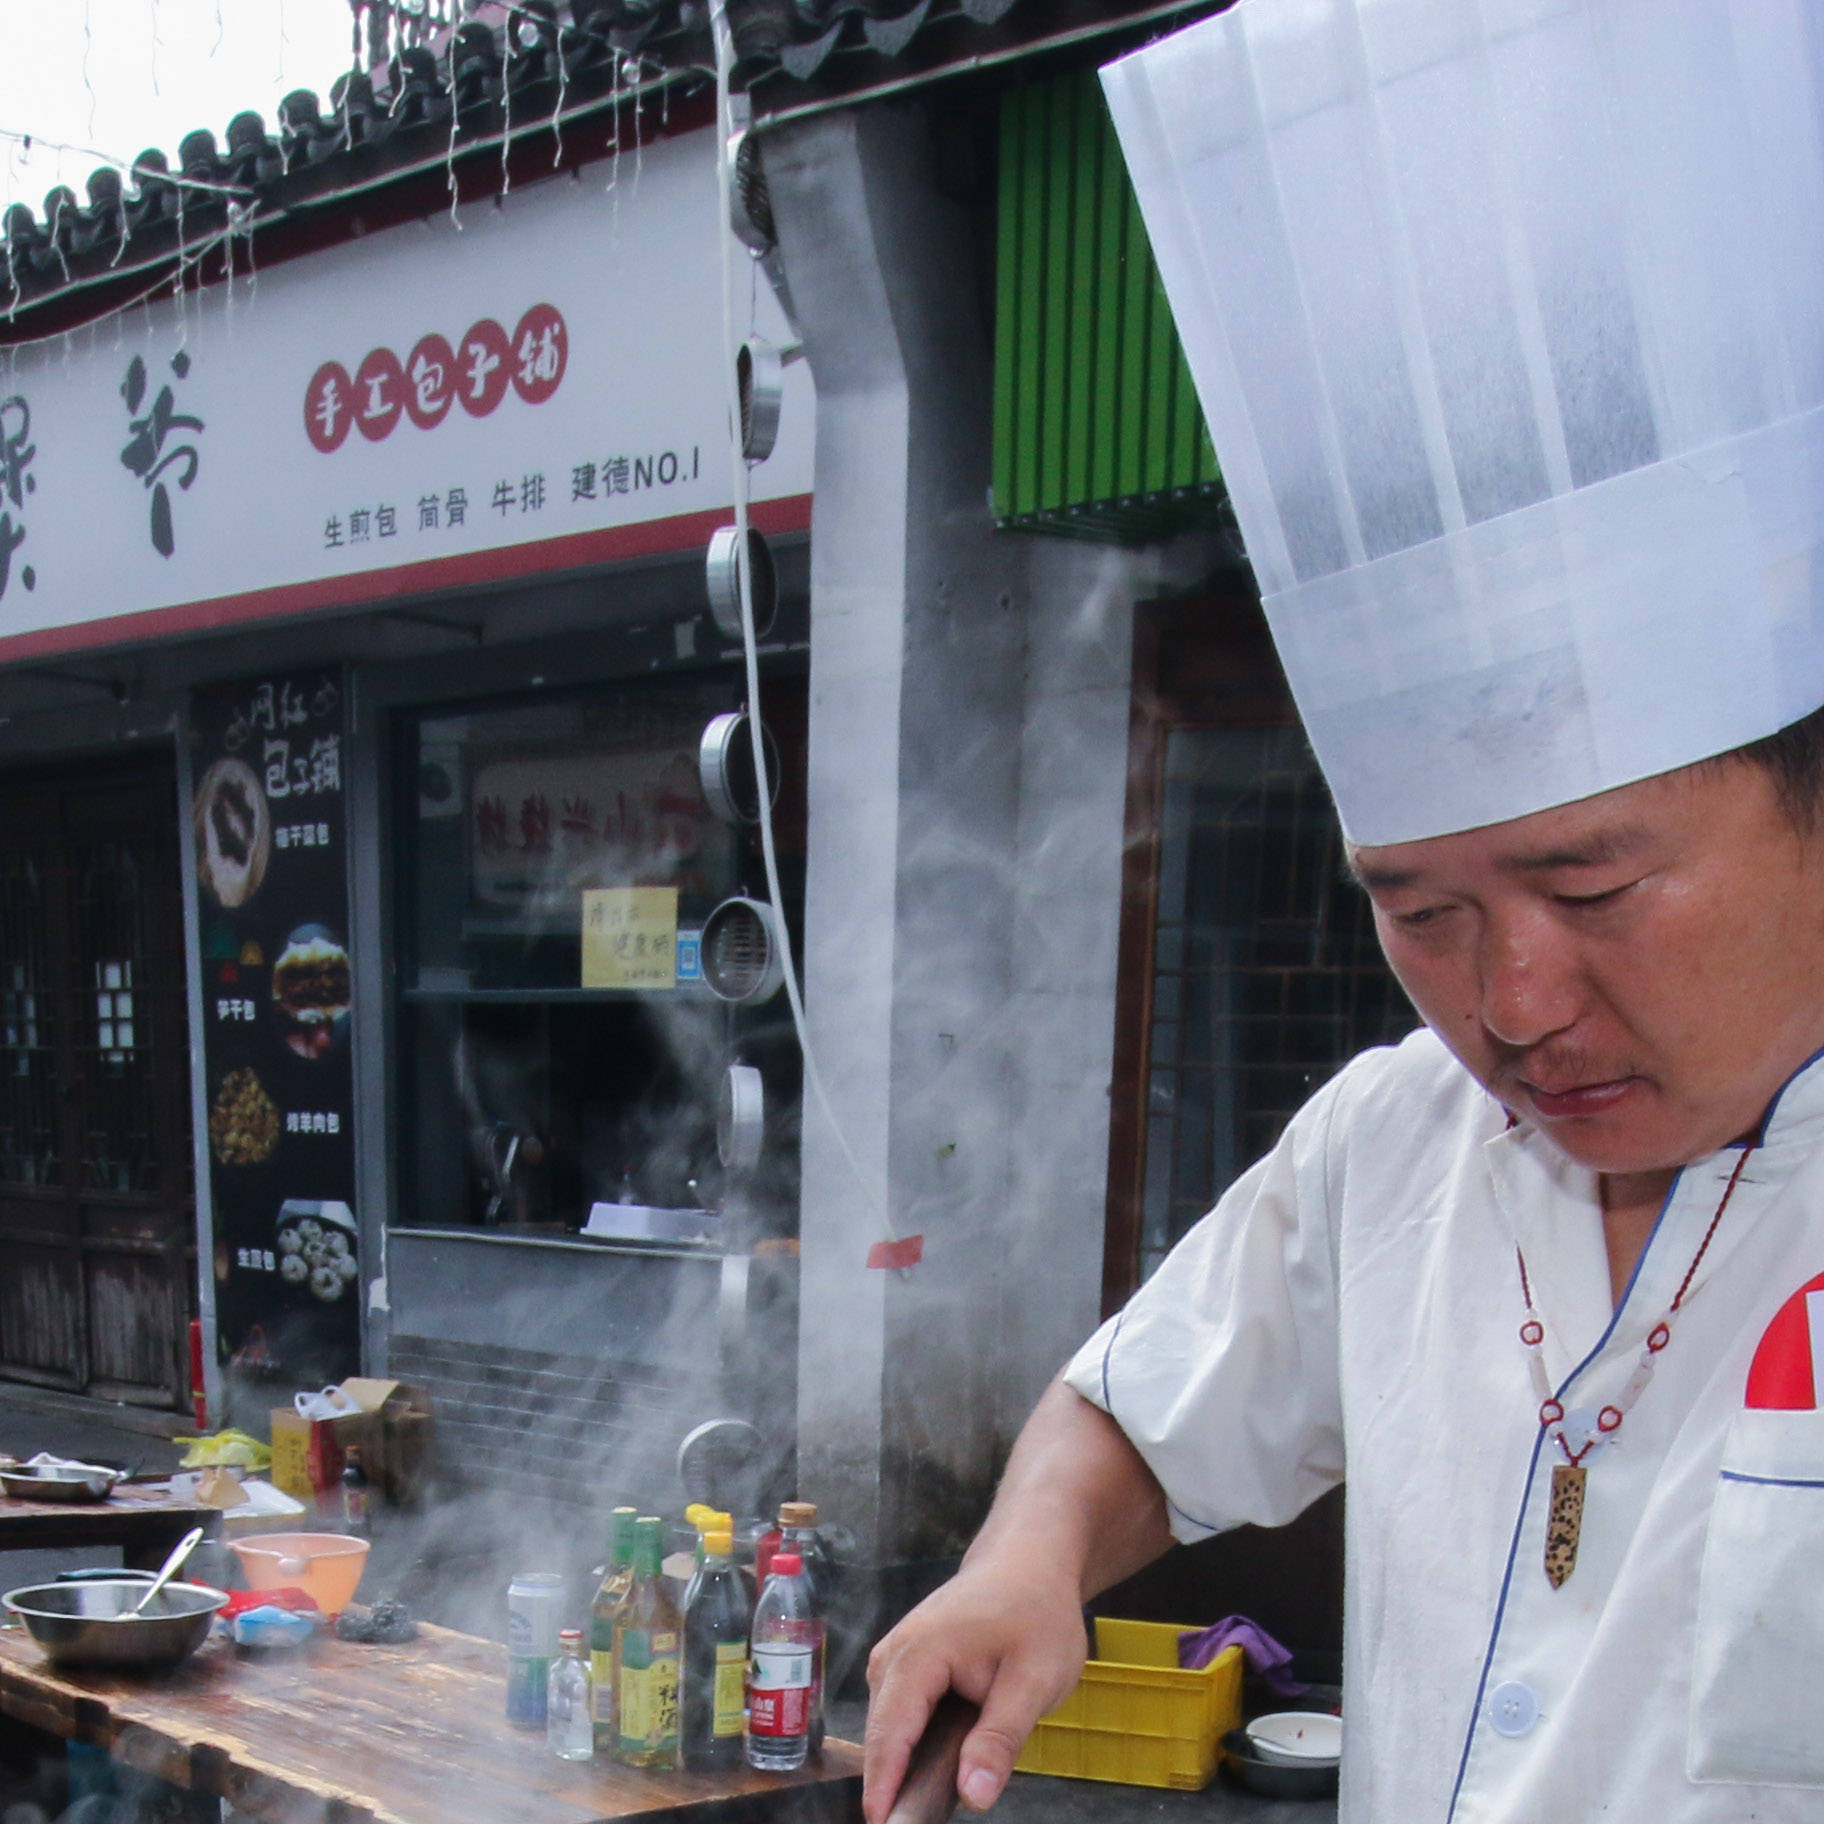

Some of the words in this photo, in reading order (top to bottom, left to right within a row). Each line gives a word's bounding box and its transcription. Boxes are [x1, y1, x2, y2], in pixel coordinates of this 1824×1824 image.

[314, 322, 562, 438] 手工包子铺
[323, 502, 398, 550] 生煎包
[418, 486, 468, 534] 筒骨
[492, 472, 547, 517] 牛排
